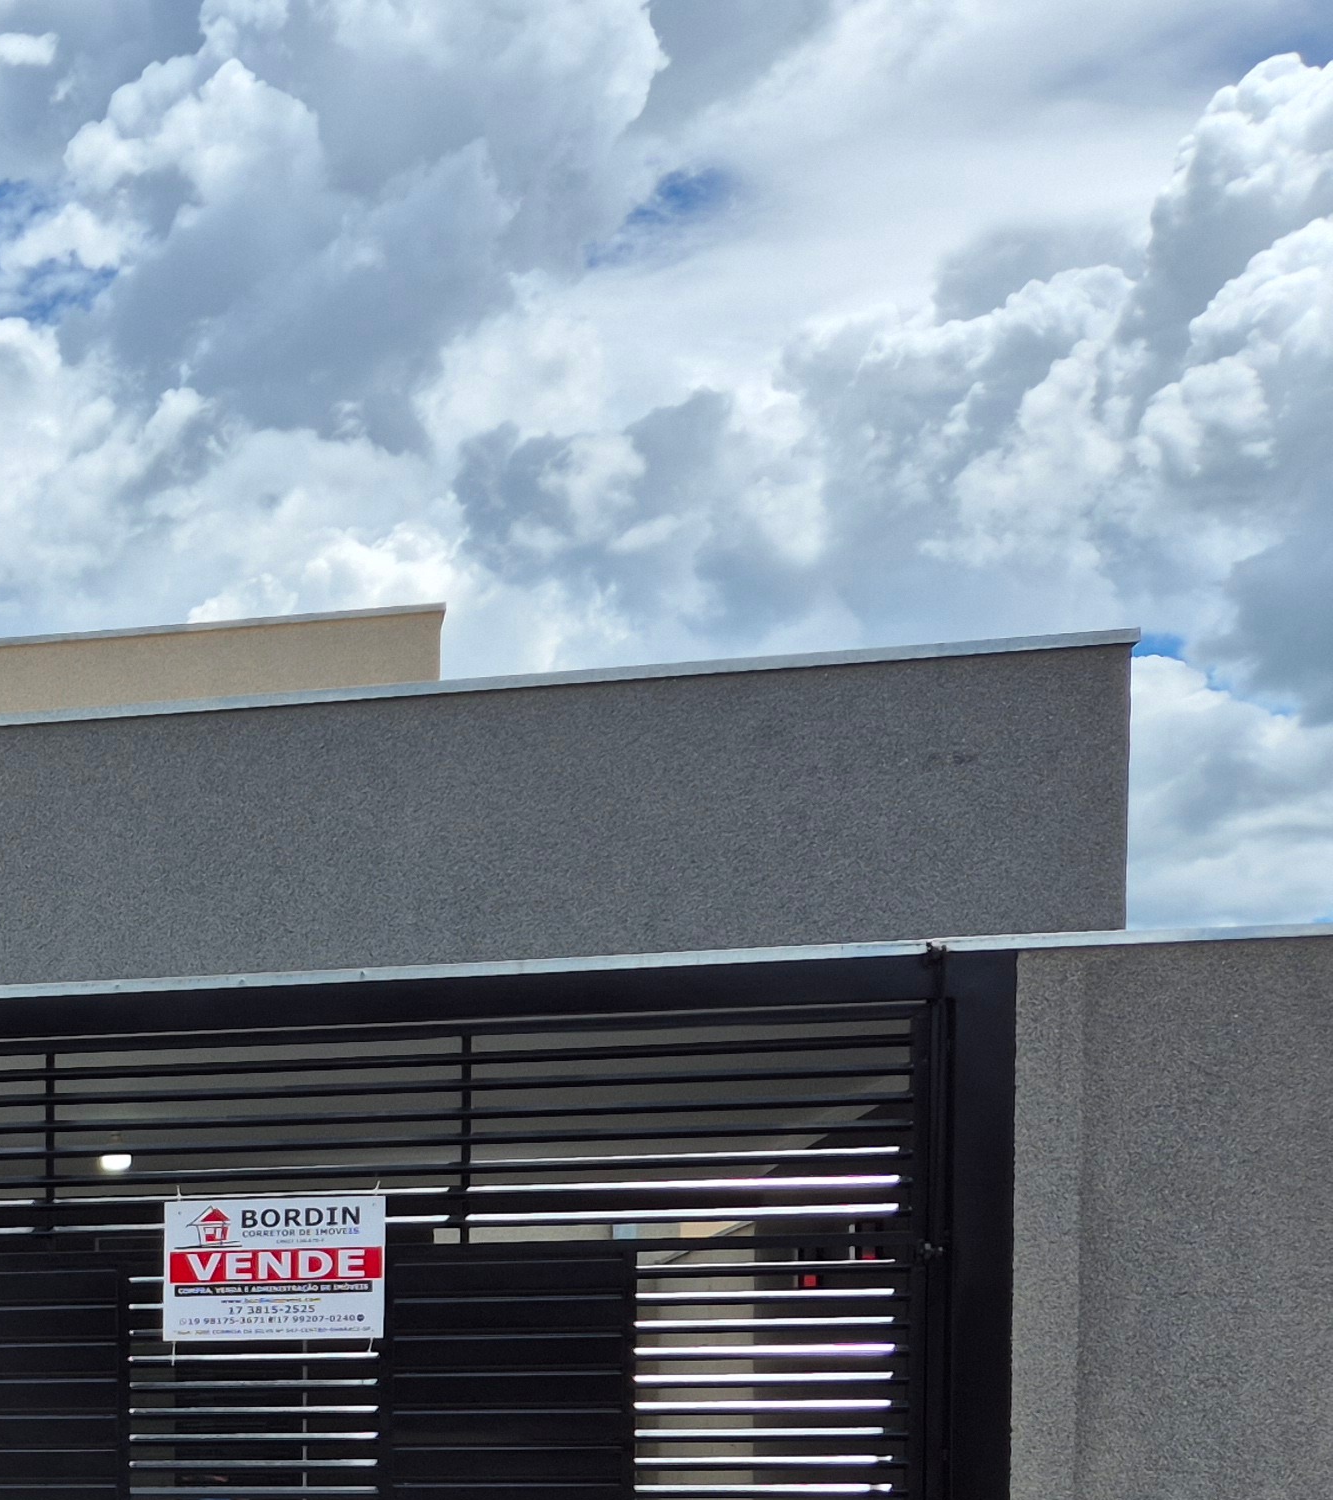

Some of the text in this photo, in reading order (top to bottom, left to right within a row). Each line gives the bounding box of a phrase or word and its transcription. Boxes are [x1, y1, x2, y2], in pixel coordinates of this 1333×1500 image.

[241, 1206, 360, 1229] BORDIN
[242, 1229, 296, 1238] CORRETOR
[299, 1228, 311, 1236] DE
[186, 1249, 365, 1281] VENDE
[229, 1304, 316, 1315] 17 3815-2525
[188, 1317, 201, 1326] 19
[203, 1316, 265, 1325] 98175-3671
[277, 1316, 289, 1324] 17
